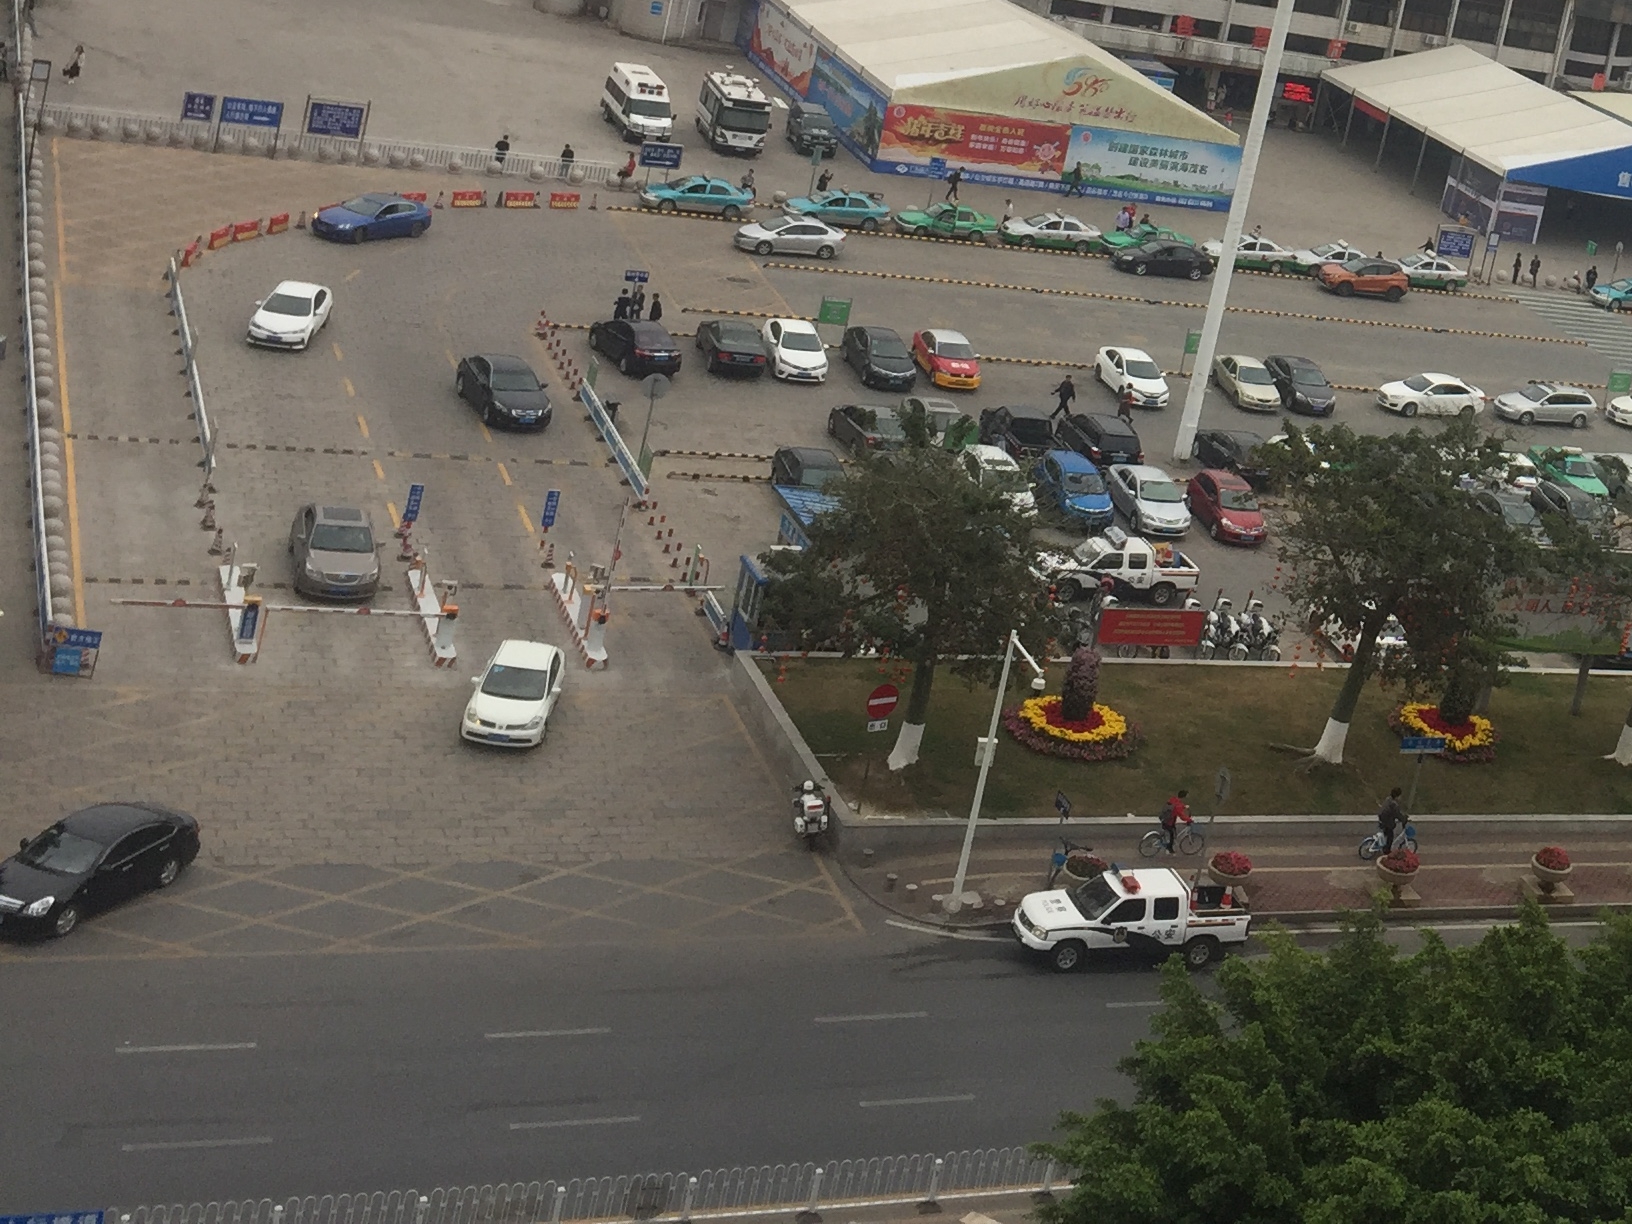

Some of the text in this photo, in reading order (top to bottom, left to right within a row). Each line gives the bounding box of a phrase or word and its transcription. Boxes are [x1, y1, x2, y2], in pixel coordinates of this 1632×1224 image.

[1107, 140, 1190, 161] 创建国家森林城市
[1127, 156, 1209, 176] 建设美丽滨海茂名
[1152, 928, 1176, 940] 公安
